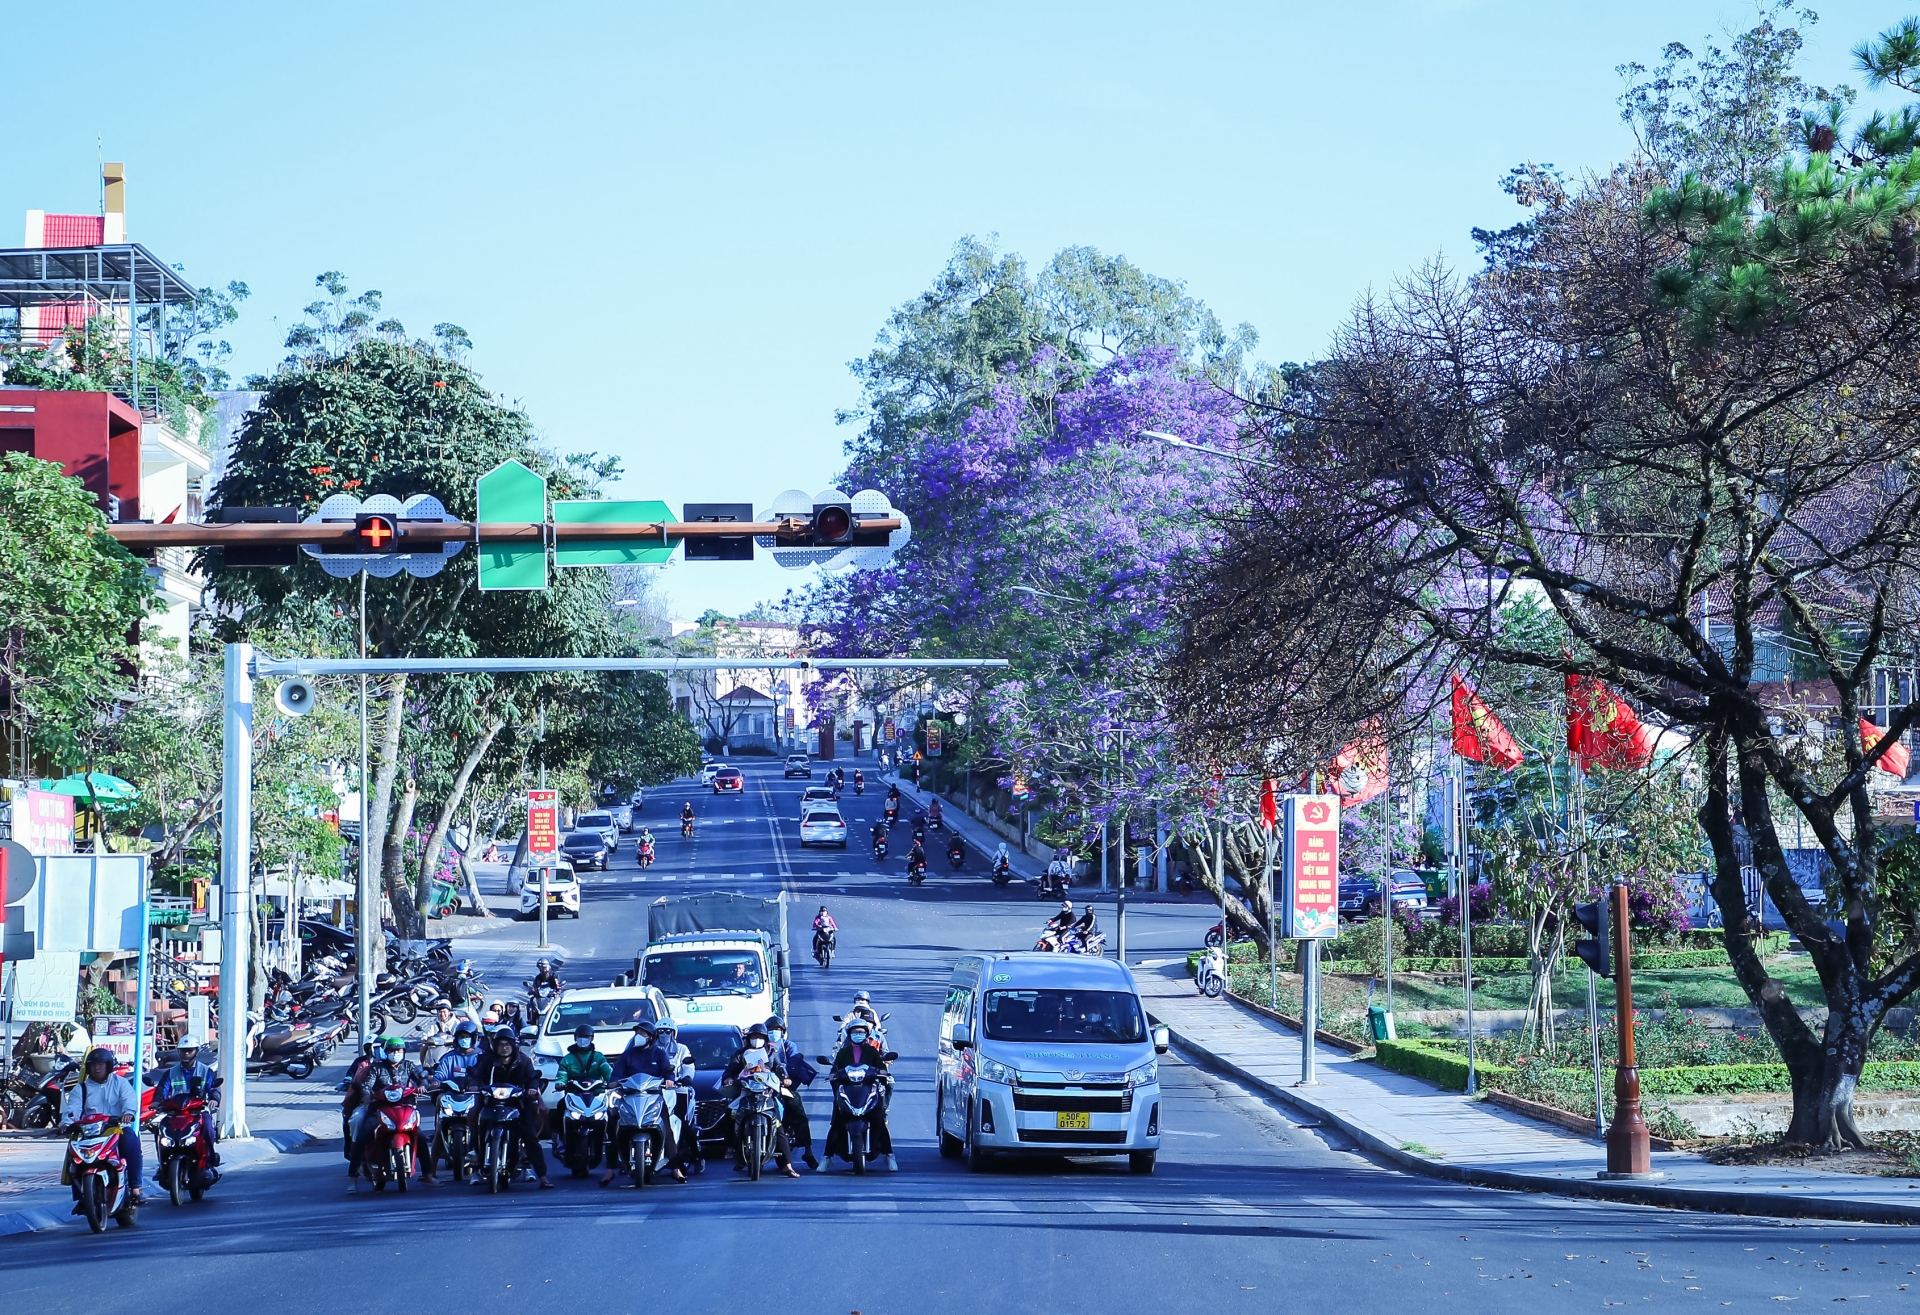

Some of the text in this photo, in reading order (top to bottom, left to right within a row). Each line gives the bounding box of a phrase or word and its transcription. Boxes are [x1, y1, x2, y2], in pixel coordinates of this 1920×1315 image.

[1302, 864, 1328, 877] VIỆT NAM
[1298, 880, 1331, 890] QUANG VINH
